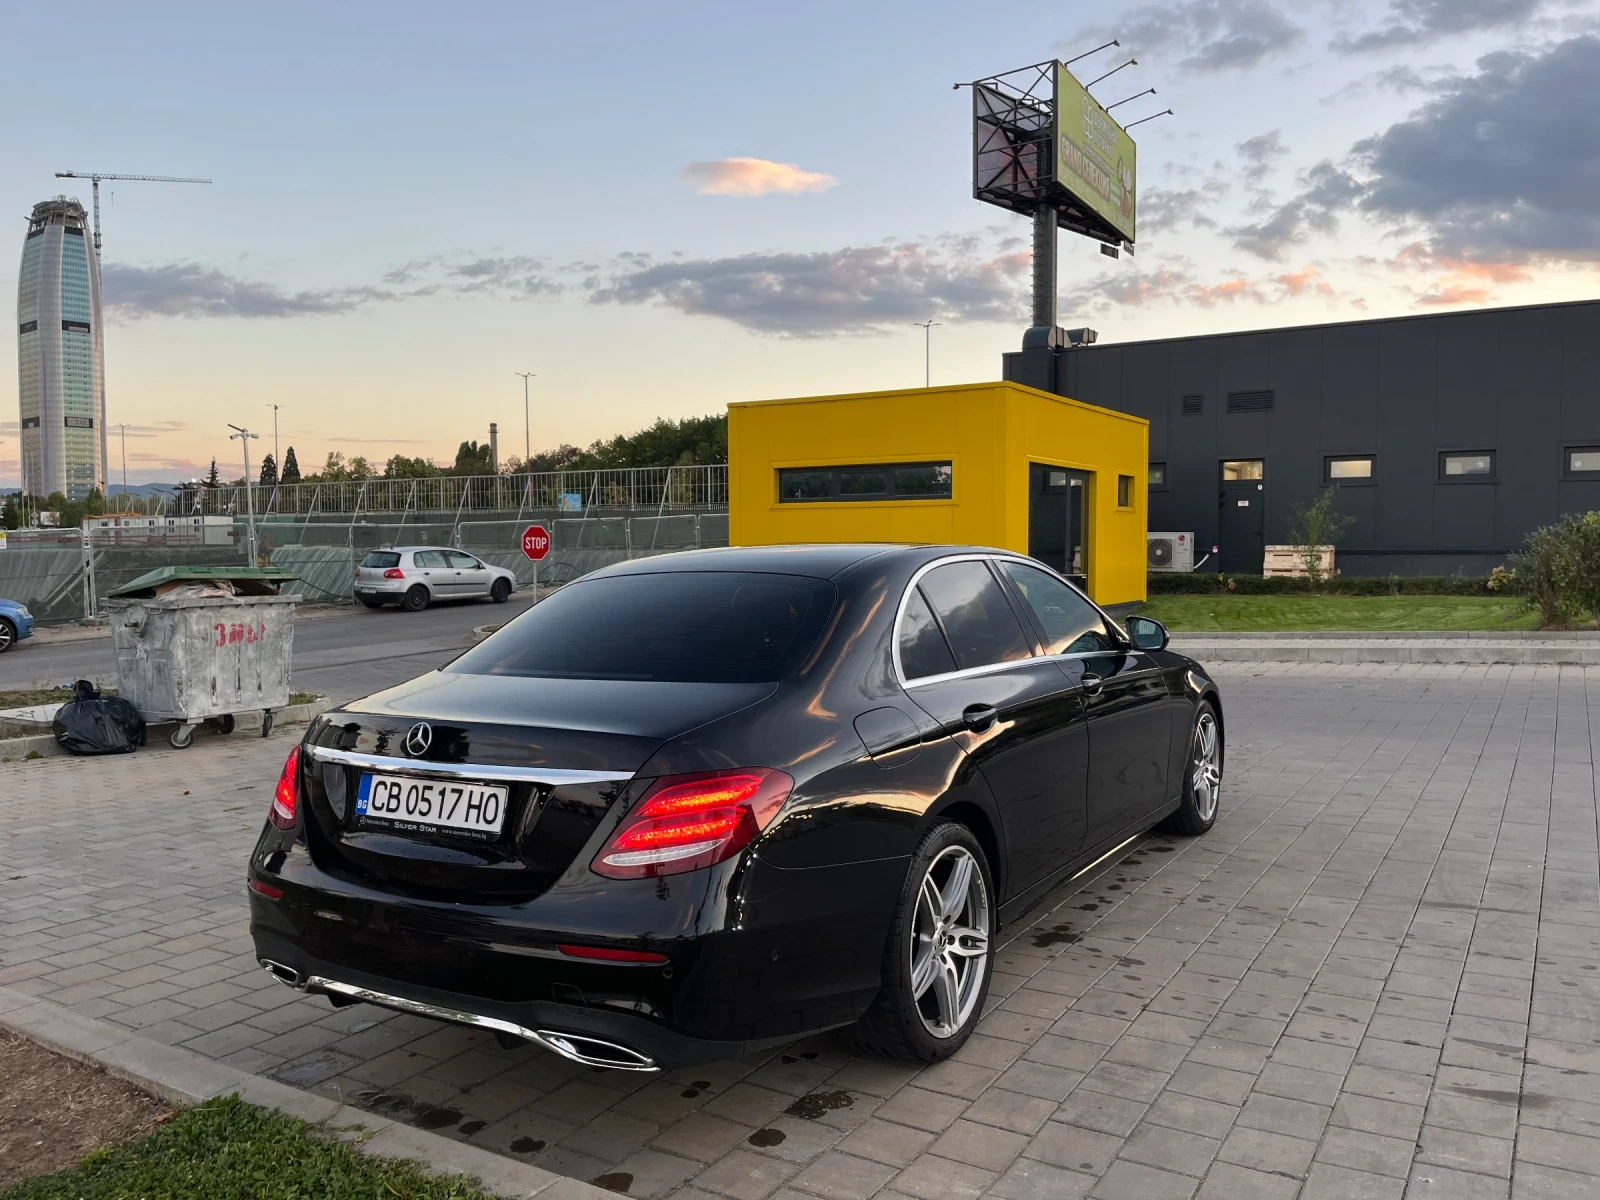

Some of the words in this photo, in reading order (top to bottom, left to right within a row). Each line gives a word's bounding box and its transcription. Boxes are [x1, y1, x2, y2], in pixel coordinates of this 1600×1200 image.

[1062, 136, 1082, 174] GRAND
[525, 536, 547, 550] STOP
[357, 799, 368, 809] BG
[372, 780, 402, 813] CB
[406, 784, 464, 820] 0517
[465, 790, 499, 825] HO
[366, 818, 390, 827] Mercedes-Benz
[393, 821, 417, 831] SILVER
[419, 824, 437, 833] STAR
